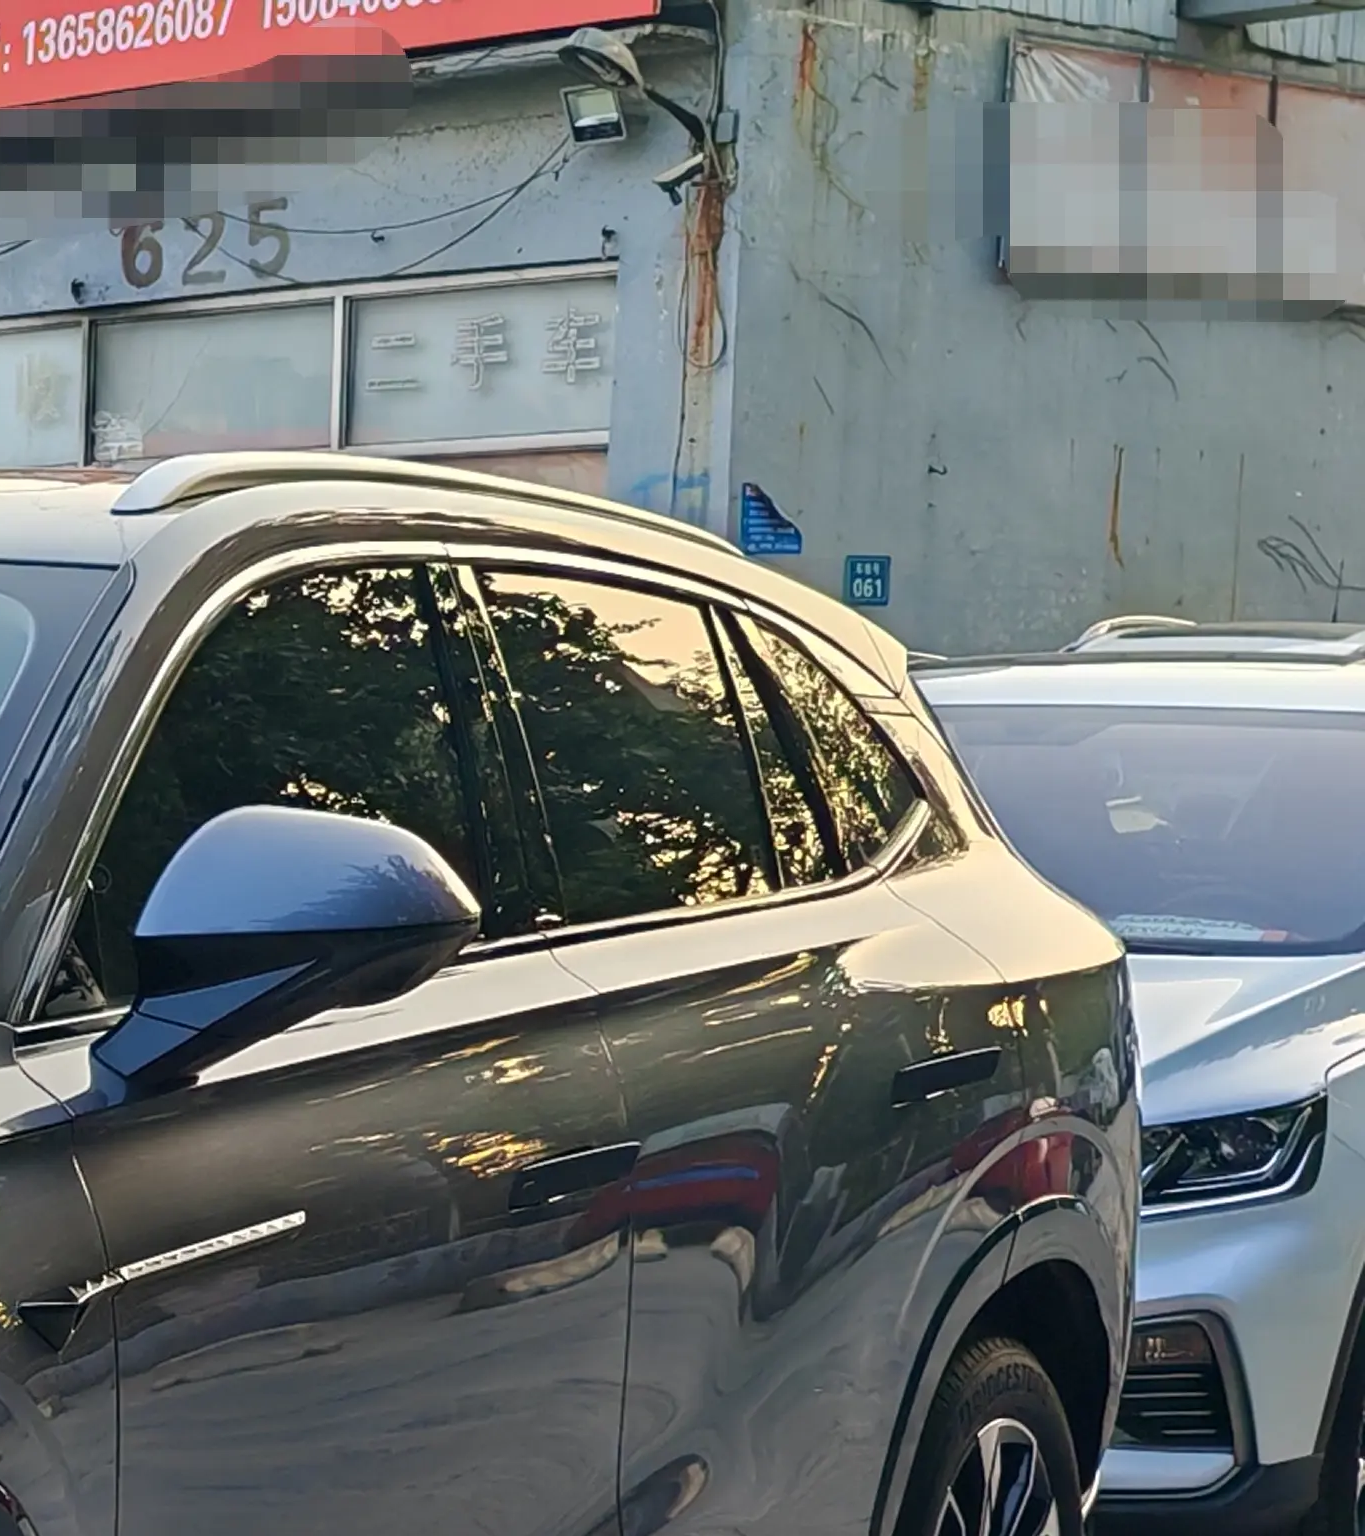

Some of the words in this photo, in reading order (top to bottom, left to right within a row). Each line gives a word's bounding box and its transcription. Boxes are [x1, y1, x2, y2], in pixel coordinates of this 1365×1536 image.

[120, 196, 290, 289] 625
[365, 307, 601, 391] 二手车
[852, 578, 883, 598] 061
